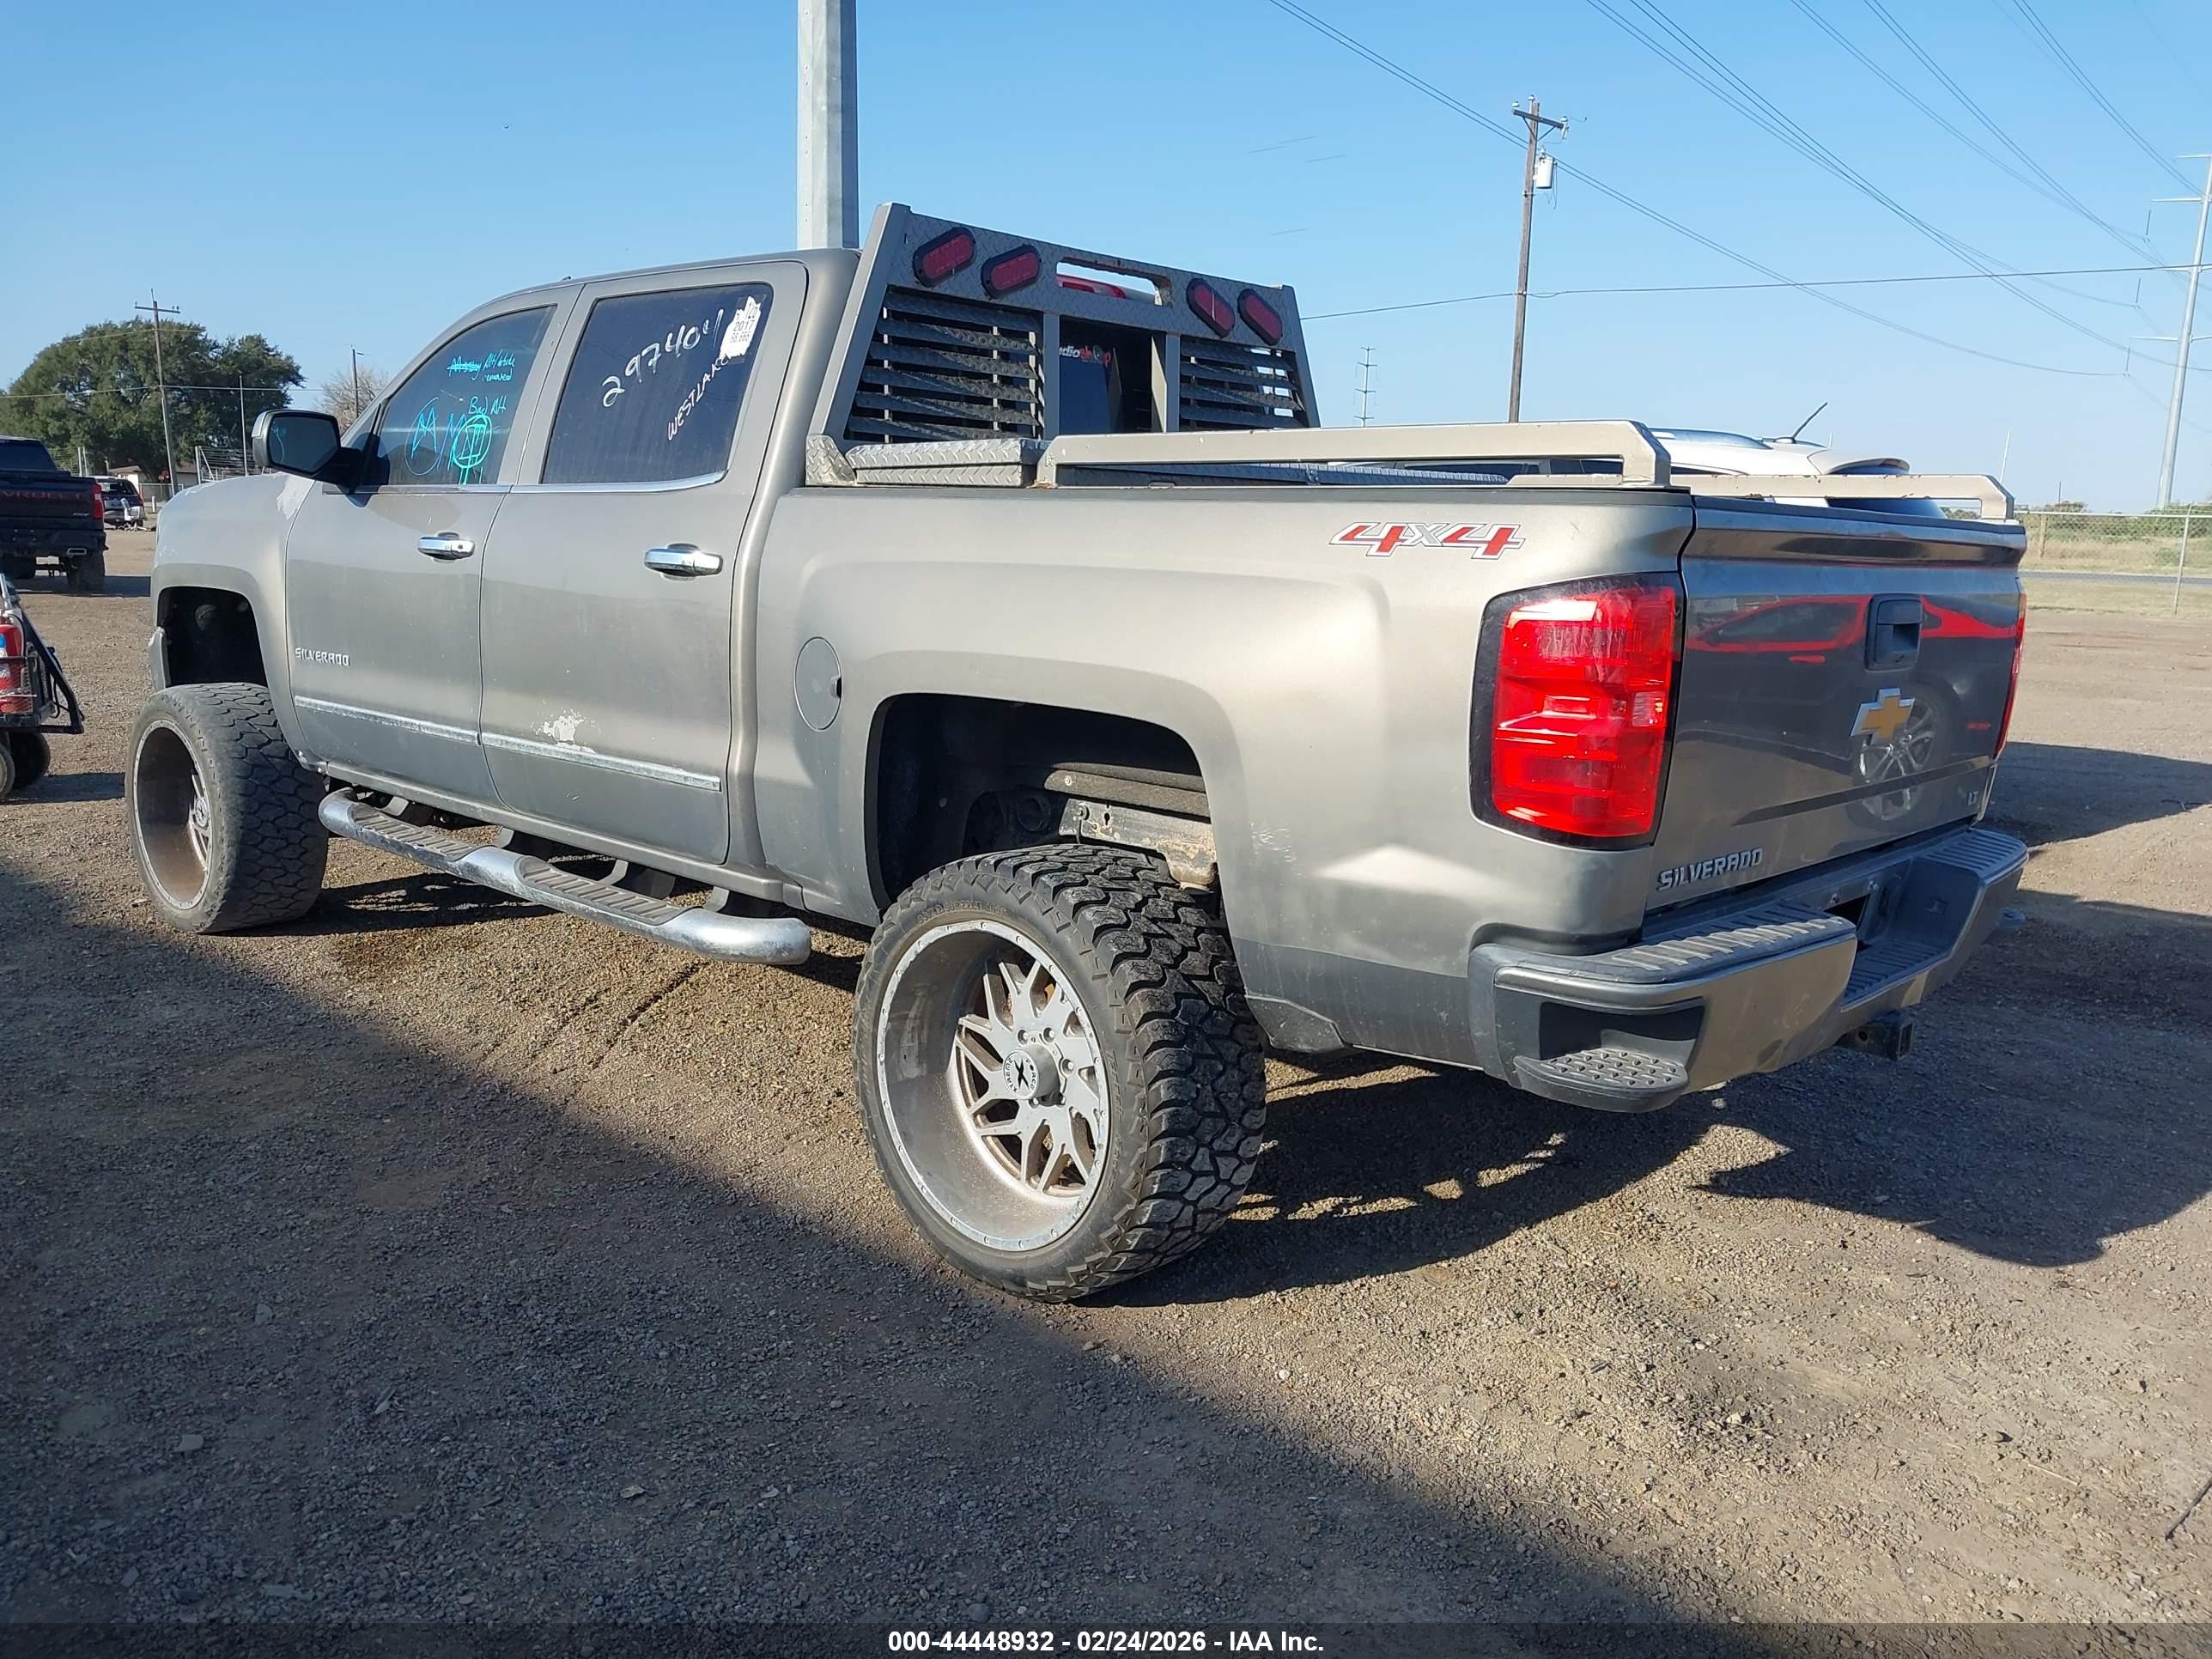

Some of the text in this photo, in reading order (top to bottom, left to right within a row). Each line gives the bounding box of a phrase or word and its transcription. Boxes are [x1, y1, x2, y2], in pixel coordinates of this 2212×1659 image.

[733, 319, 756, 332] 2017
[295, 647, 350, 667] SILVERADO
[1656, 848, 1763, 891] SILVERADO
